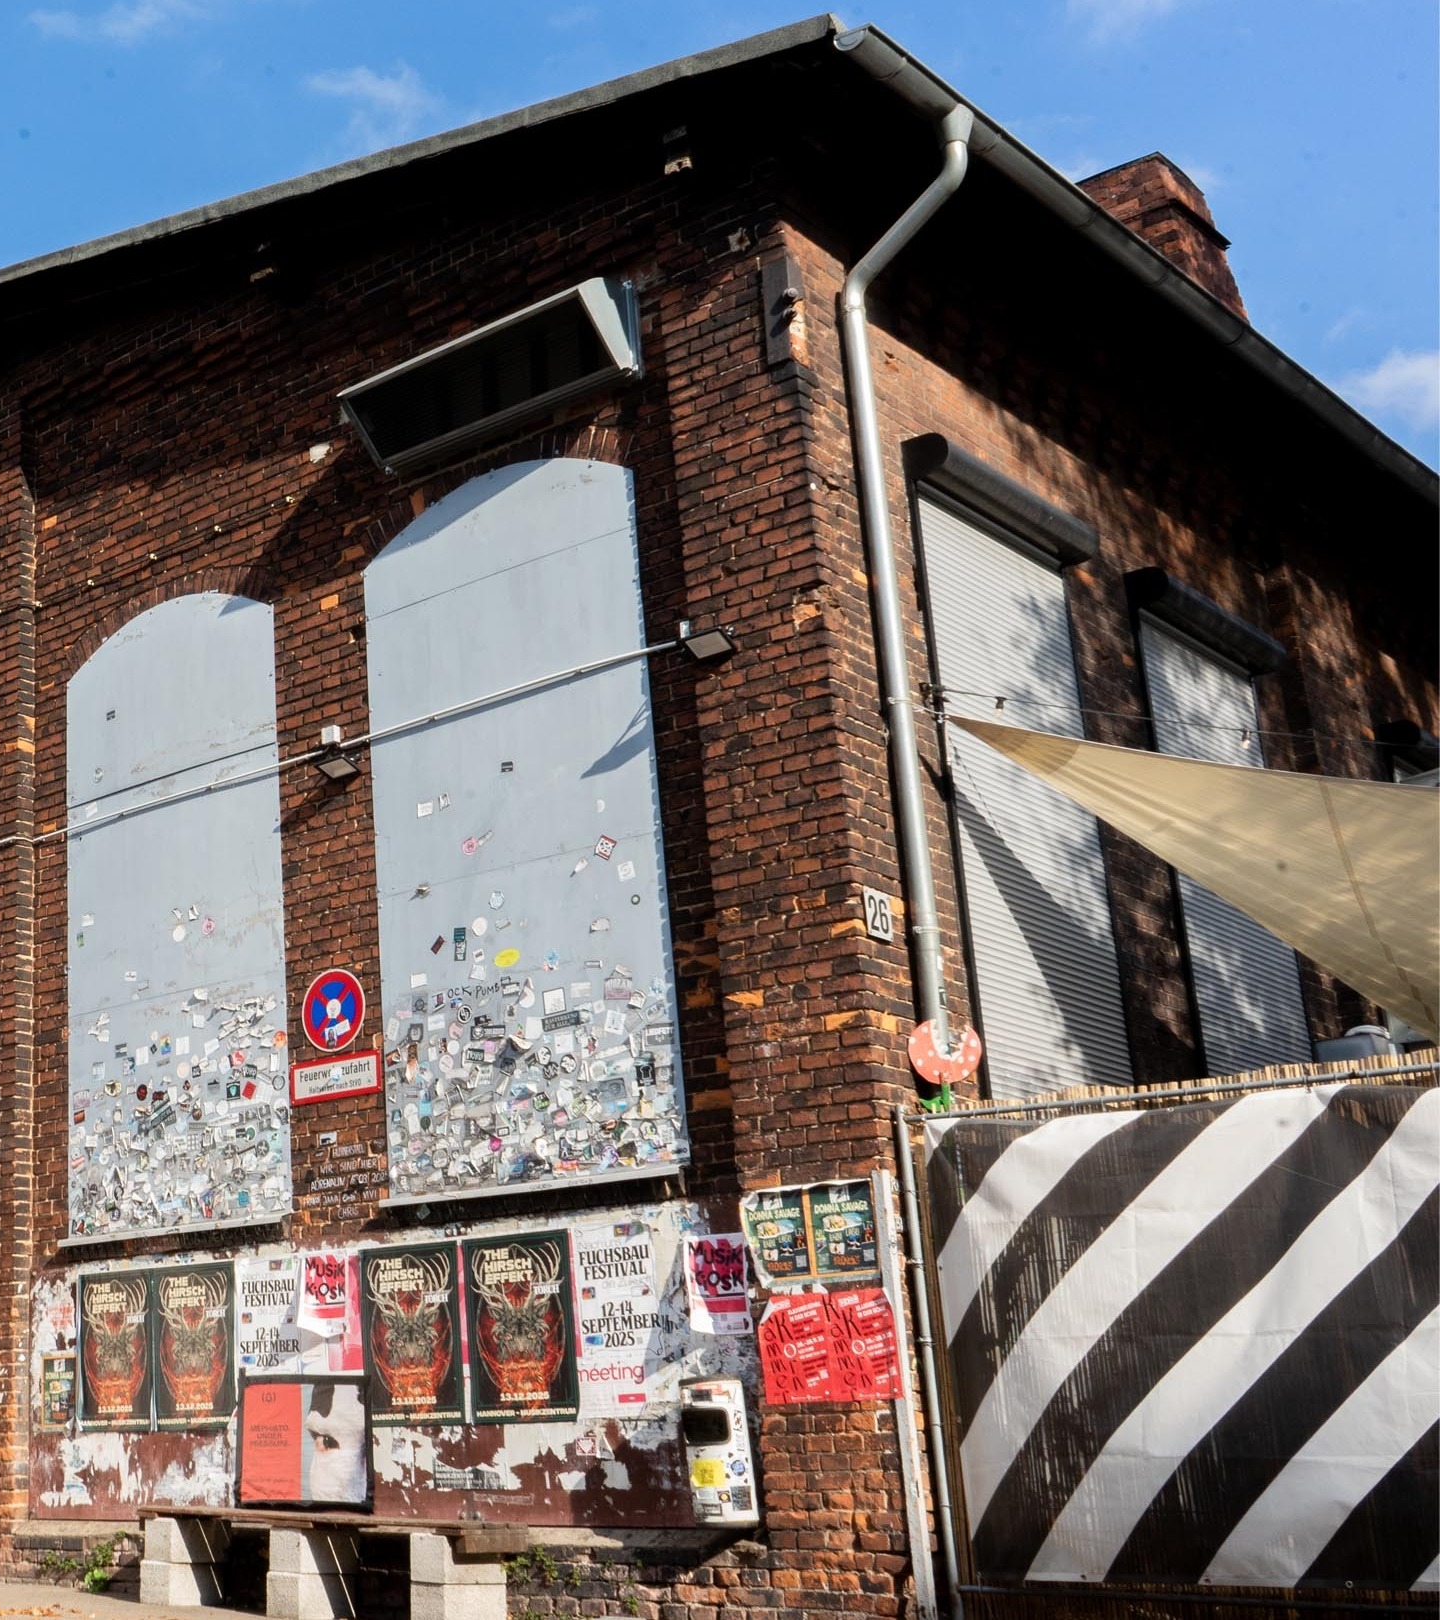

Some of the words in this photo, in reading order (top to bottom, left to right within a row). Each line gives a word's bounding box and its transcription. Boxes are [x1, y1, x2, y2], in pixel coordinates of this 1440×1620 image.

[868, 894, 890, 934] 26
[299, 1060, 370, 1083] Feuerwzufahrt
[336, 1081, 348, 1090] nach
[361, 1158, 377, 1169] HIER
[337, 1206, 359, 1219] CHRIS
[813, 1203, 840, 1215] DONNA
[484, 1247, 509, 1261] THE
[578, 1244, 649, 1266] FUCHSBAU
[378, 1257, 403, 1271] THE
[484, 1258, 532, 1274] HIRSCH
[584, 1260, 647, 1281] FESTIVAL
[379, 1267, 424, 1281] HIRSCH
[484, 1270, 533, 1285] EFFEKT
[92, 1283, 111, 1293] THE
[168, 1276, 189, 1287] THE
[242, 1279, 295, 1295] FUCHSBAU
[379, 1279, 425, 1293] EFFEKT
[92, 1293, 127, 1304] HIRSCH
[169, 1286, 206, 1297] HIRSCH
[169, 1296, 207, 1309] EFFEKT
[244, 1292, 293, 1307] FESTIVAL
[92, 1302, 127, 1314] EFFEKT
[601, 1299, 634, 1317] 12-14
[582, 1312, 661, 1335] SEPTEMBER
[255, 1327, 280, 1341] 12-14
[604, 1331, 636, 1348] 2025
[240, 1339, 300, 1354] SEPTEMBER
[256, 1354, 280, 1367] 2025
[391, 1395, 437, 1406] 13.12.2025
[500, 1391, 550, 1402] 13.12.2025
[409, 1411, 462, 1420] MUSIKZENTRUM
[476, 1410, 516, 1418] HANNOVER
[520, 1407, 577, 1417] MUSIKZENTRUM
